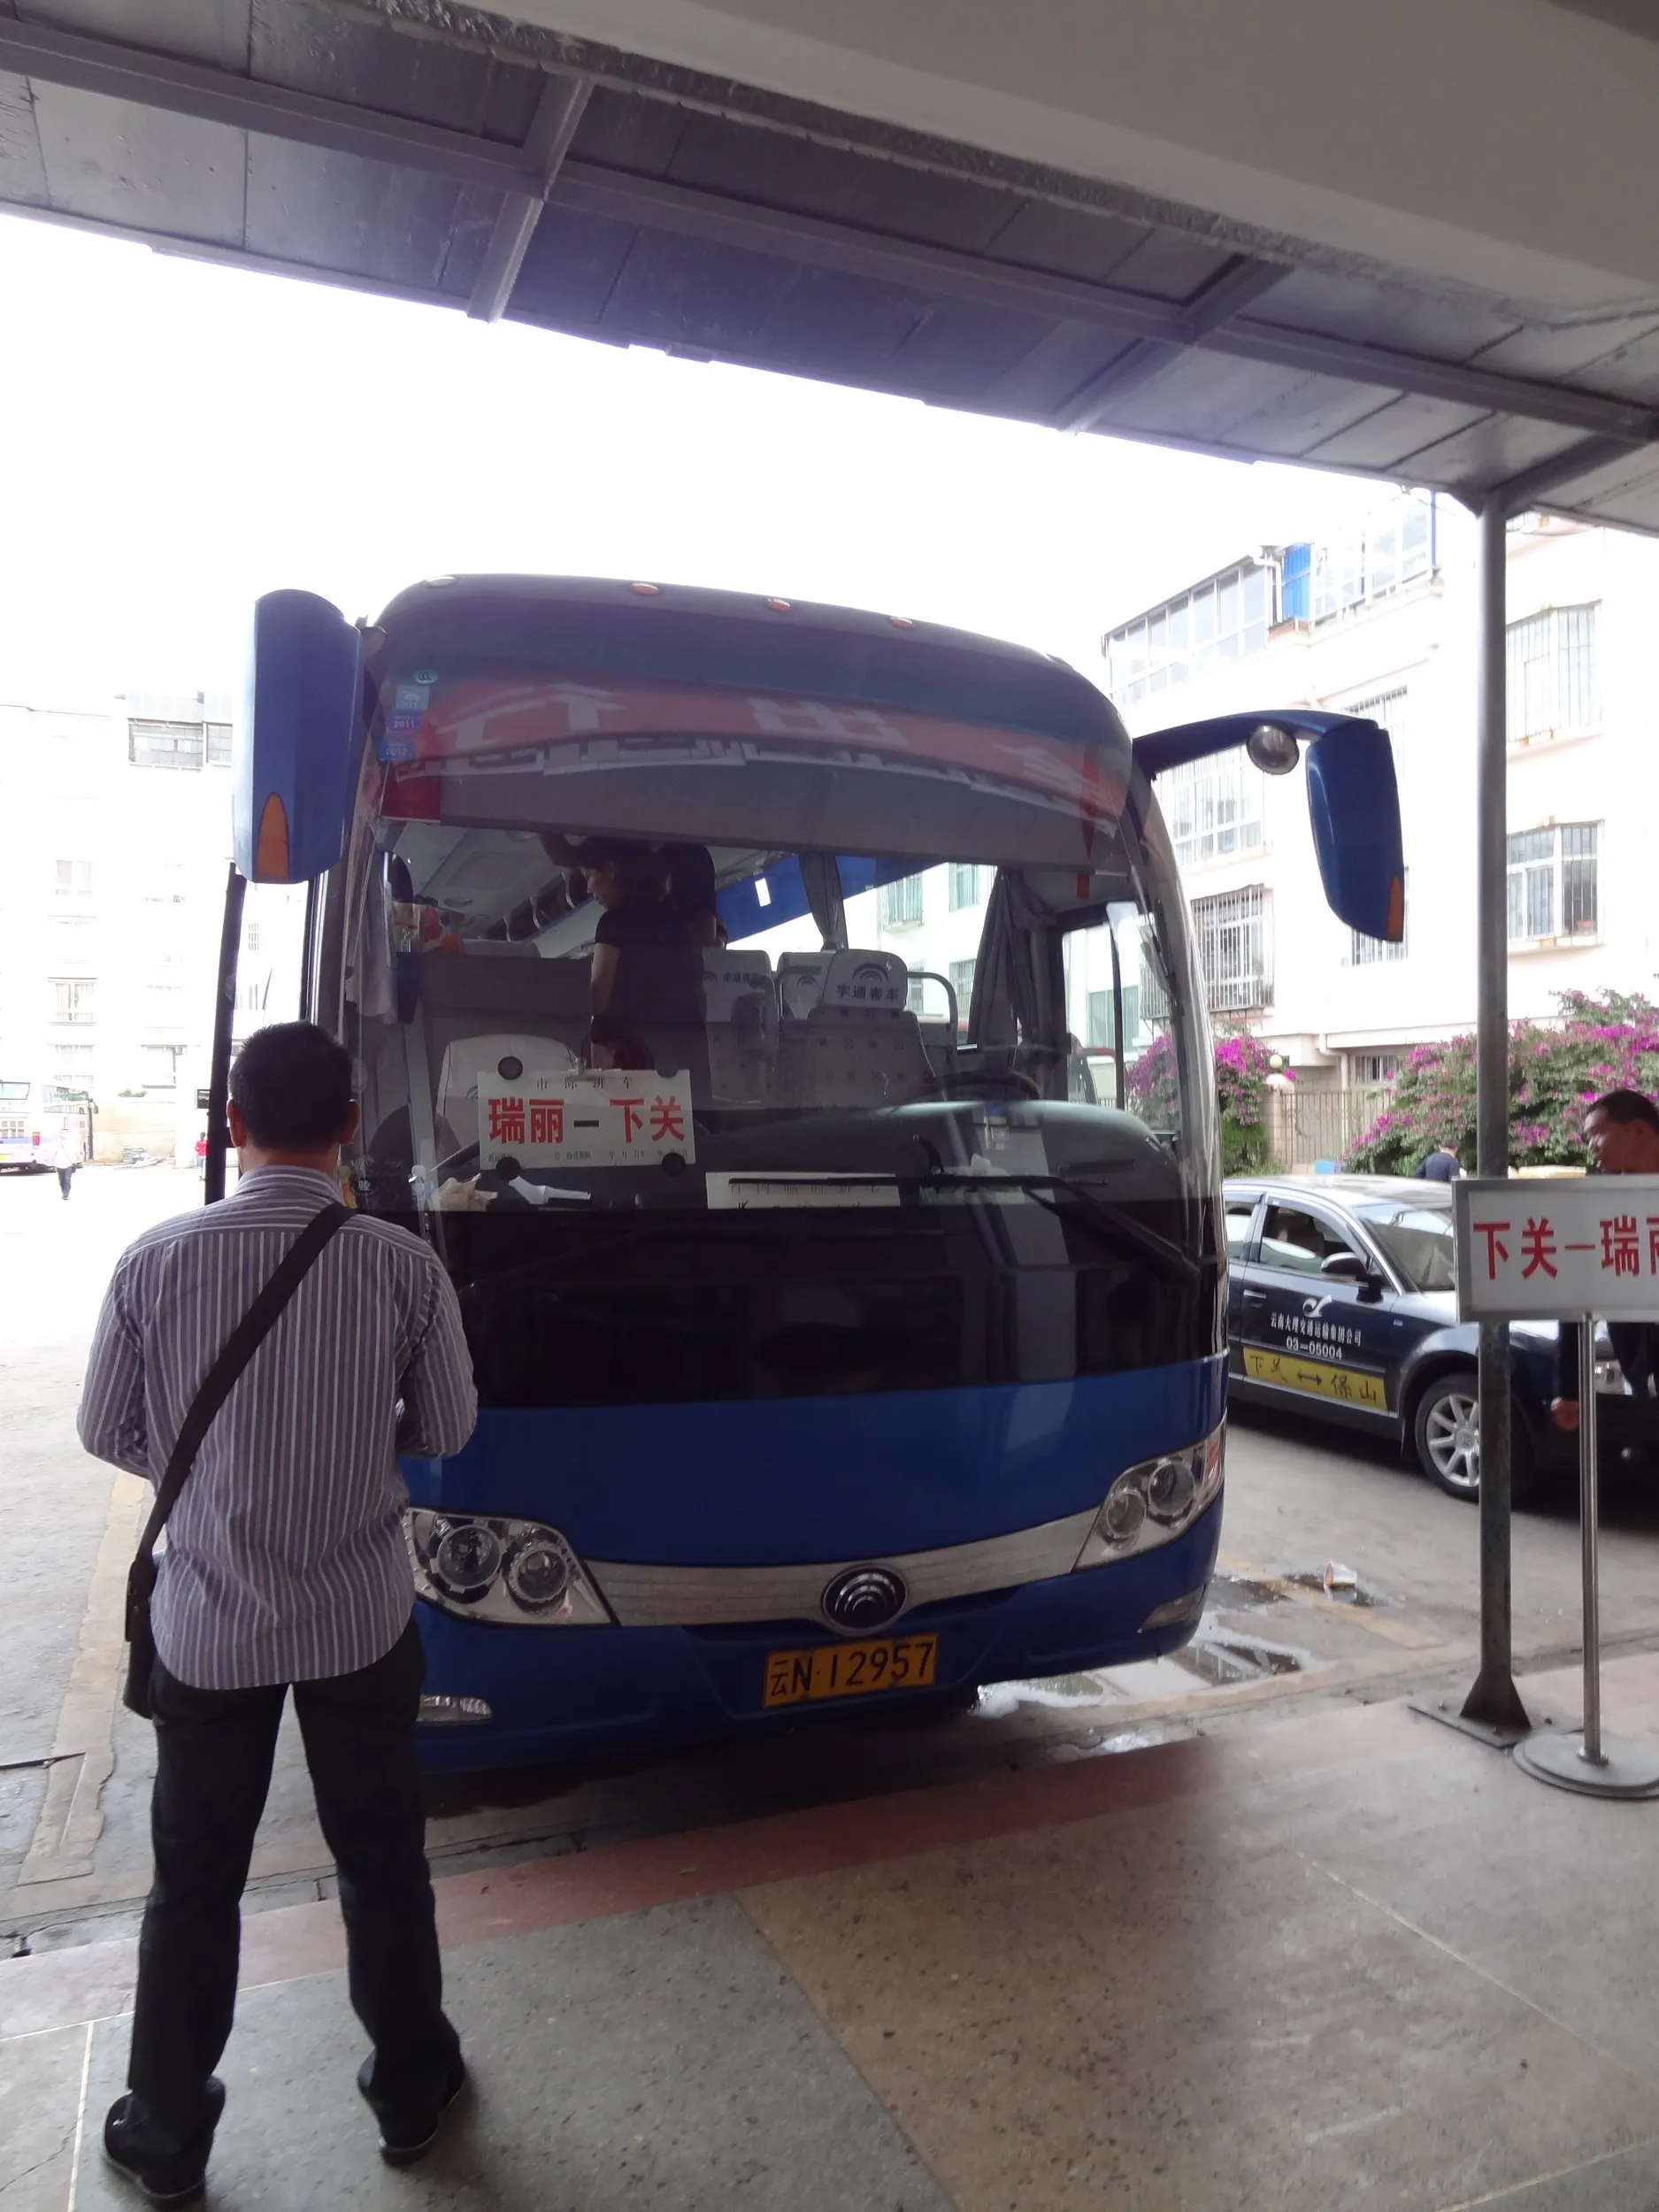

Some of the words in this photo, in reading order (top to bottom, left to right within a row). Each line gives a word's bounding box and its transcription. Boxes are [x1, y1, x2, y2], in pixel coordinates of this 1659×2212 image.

[835, 982, 901, 1002] 宇通客车
[1271, 1311, 1362, 1348] 云南大理交通运输集团公司
[1331, 1373, 1377, 1404] 保山
